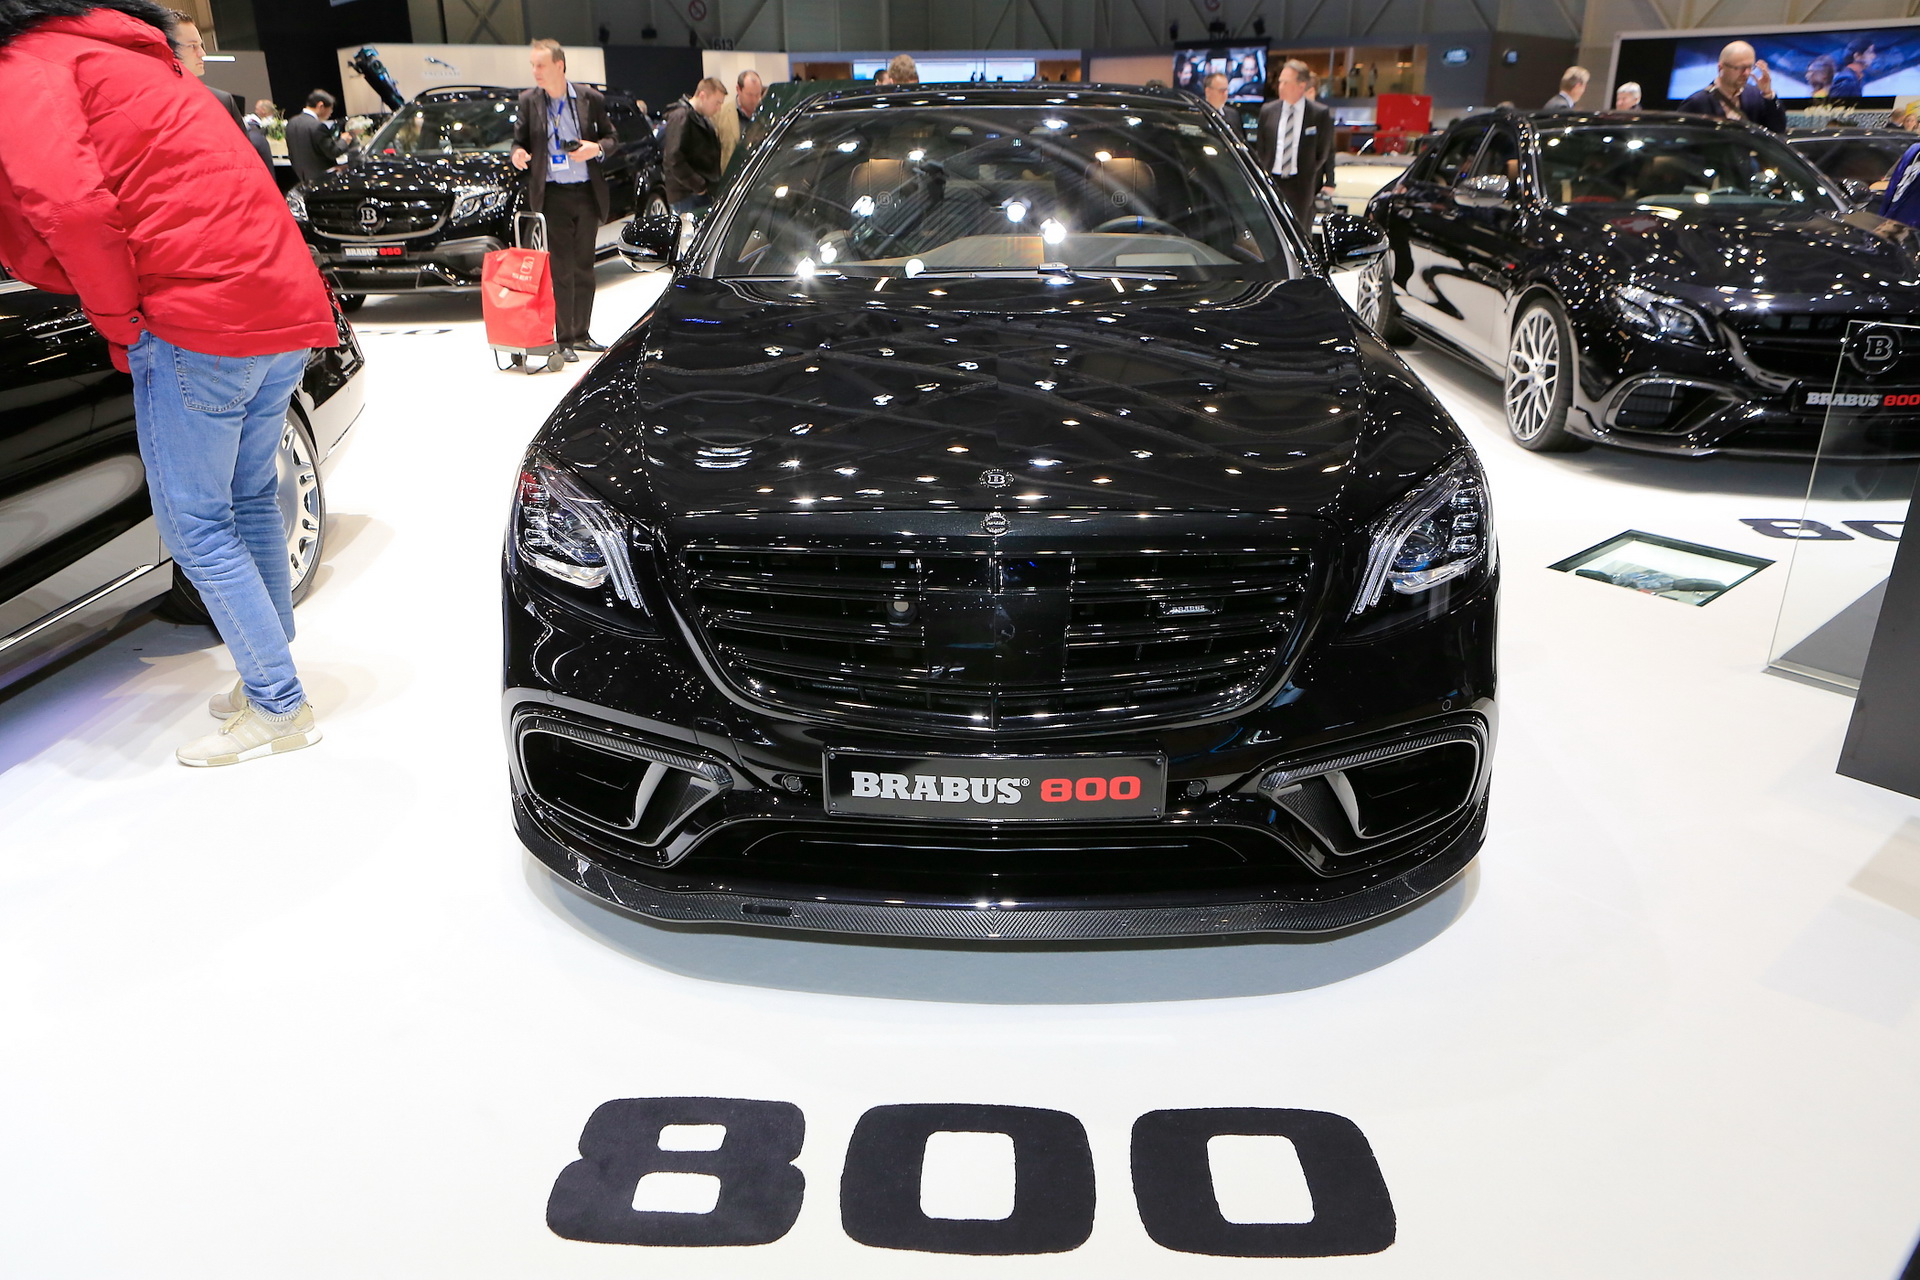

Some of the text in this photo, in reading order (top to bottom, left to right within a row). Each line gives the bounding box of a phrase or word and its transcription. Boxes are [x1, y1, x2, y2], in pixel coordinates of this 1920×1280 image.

[360, 207, 378, 225] B
[1863, 335, 1893, 361] B
[1805, 392, 1882, 407] BRABUS
[1040, 776, 1141, 803] 800
[546, 1096, 1396, 1258] 800
